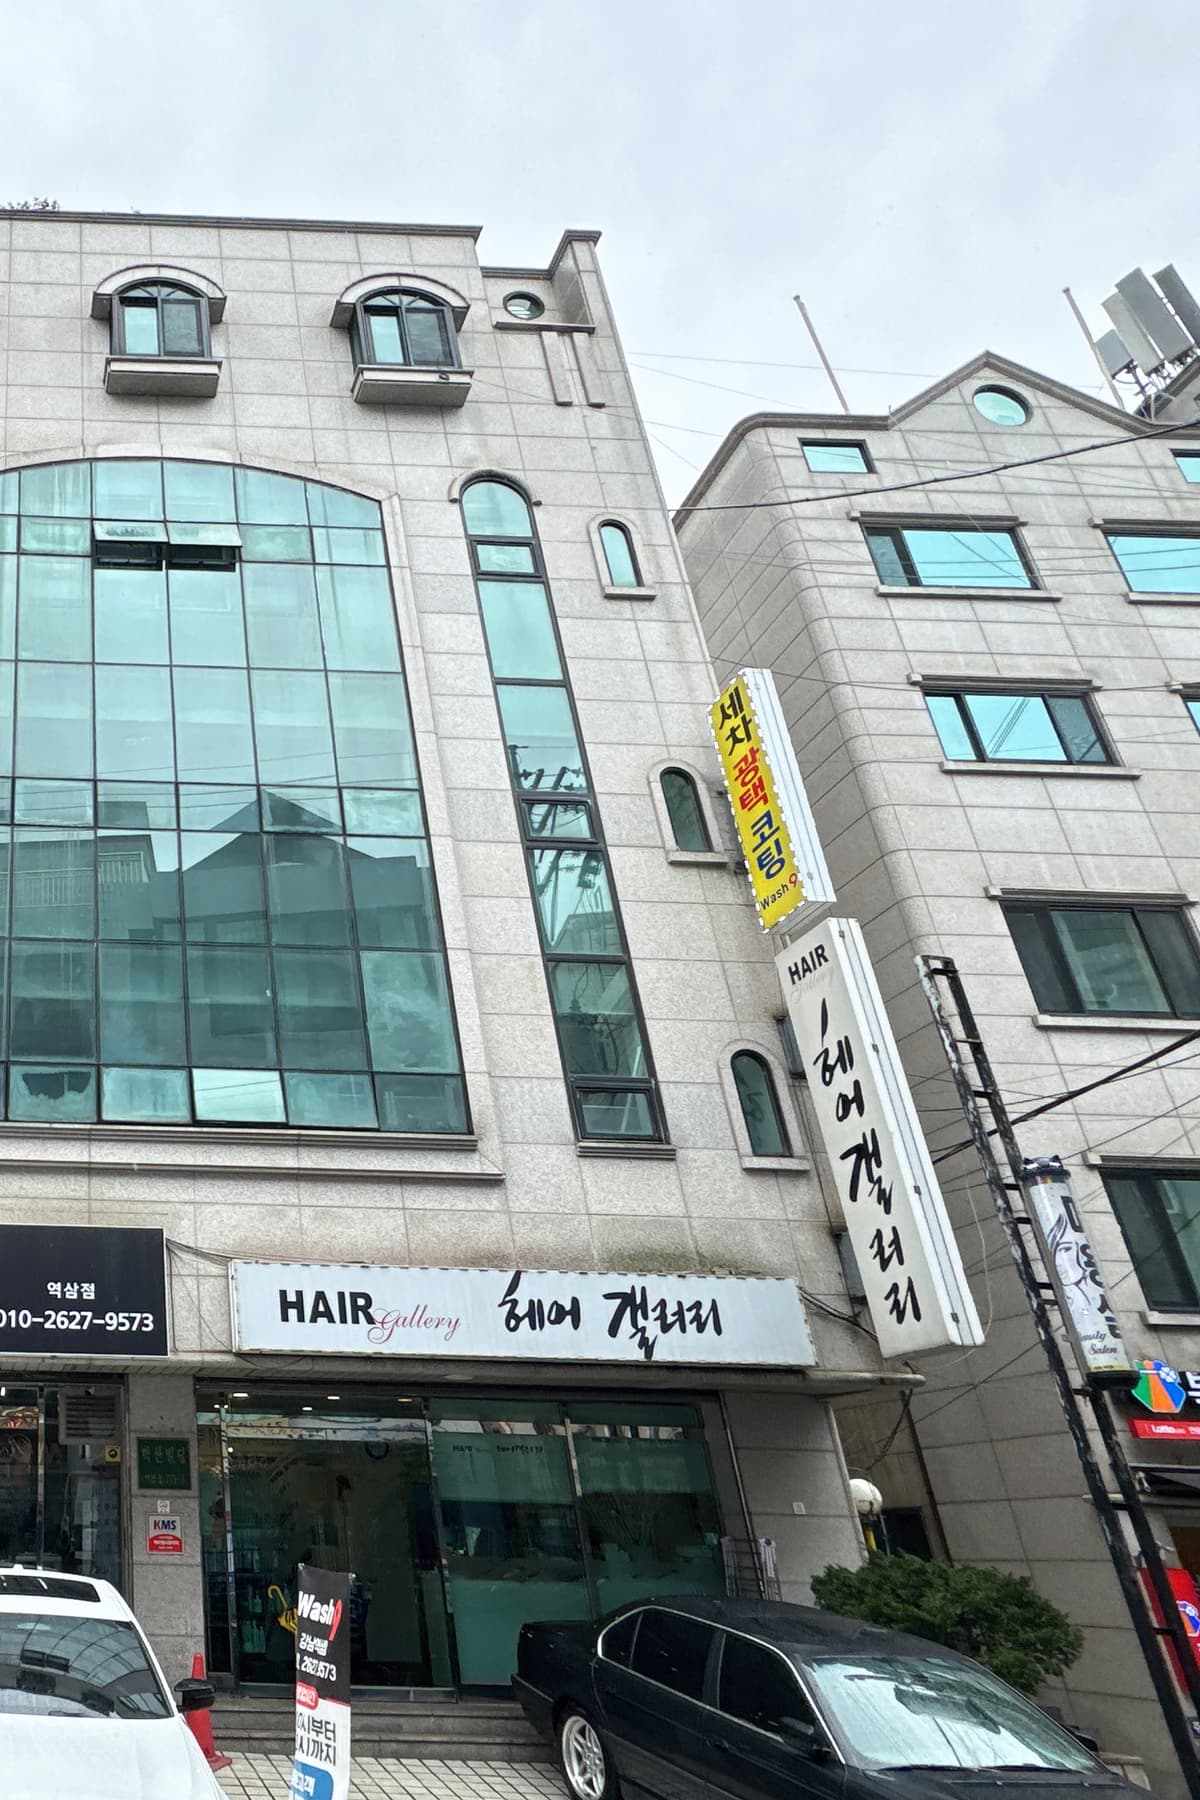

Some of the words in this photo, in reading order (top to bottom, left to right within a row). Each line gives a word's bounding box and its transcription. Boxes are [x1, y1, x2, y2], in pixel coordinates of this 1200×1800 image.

[719, 686, 752, 756] 세차
[732, 747, 768, 812] 광택
[750, 810, 786, 880] 코팅
[760, 883, 789, 910] Wash
[788, 944, 829, 986] HAIR
[47, 1281, 96, 1301] 역삼점
[278, 1289, 375, 1325] HAIR
[498, 1270, 580, 1334] 헤어
[602, 1284, 722, 1360] 갤러리
[153, 1519, 176, 1531] KMS
